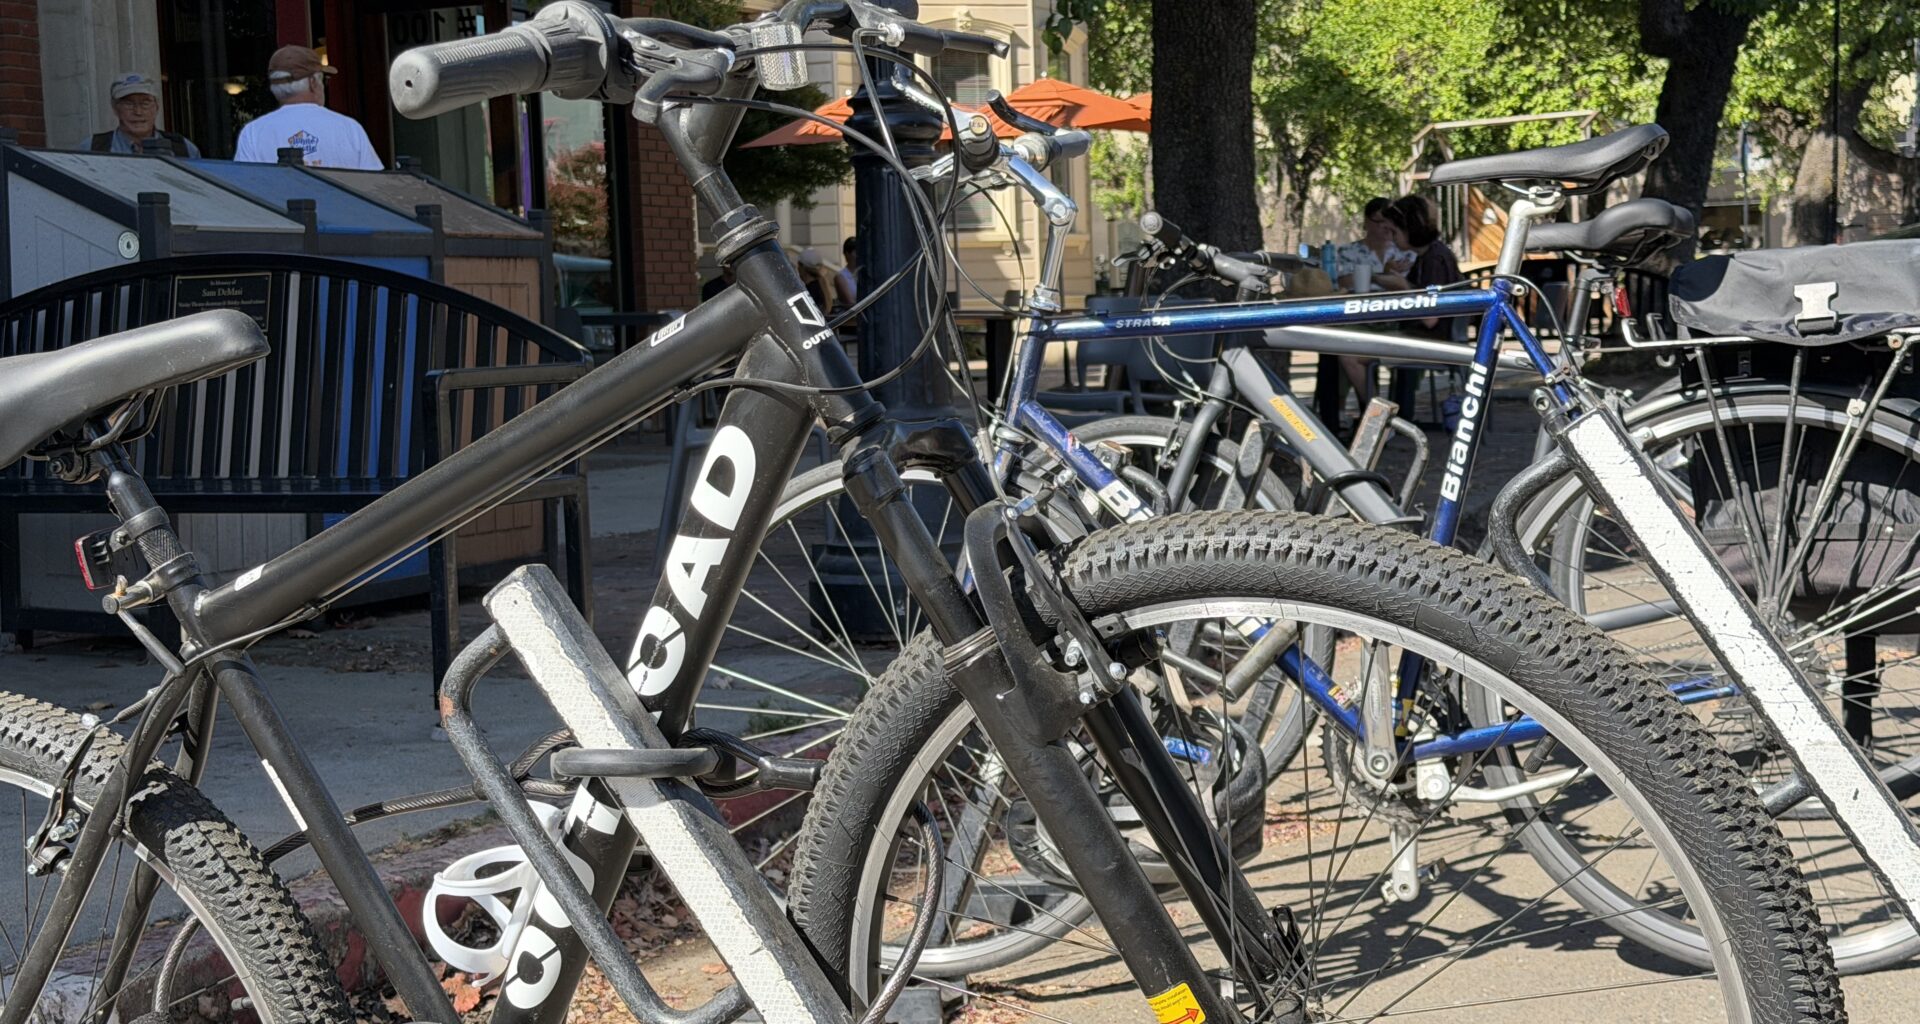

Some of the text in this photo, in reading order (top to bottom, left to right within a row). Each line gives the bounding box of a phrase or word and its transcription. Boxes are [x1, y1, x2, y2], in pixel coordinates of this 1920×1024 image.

[201, 288, 216, 297] Sam
[1344, 294, 1438, 314] Bianchi
[1115, 316, 1171, 329] STRADA
[1440, 361, 1488, 502] Bianchi
